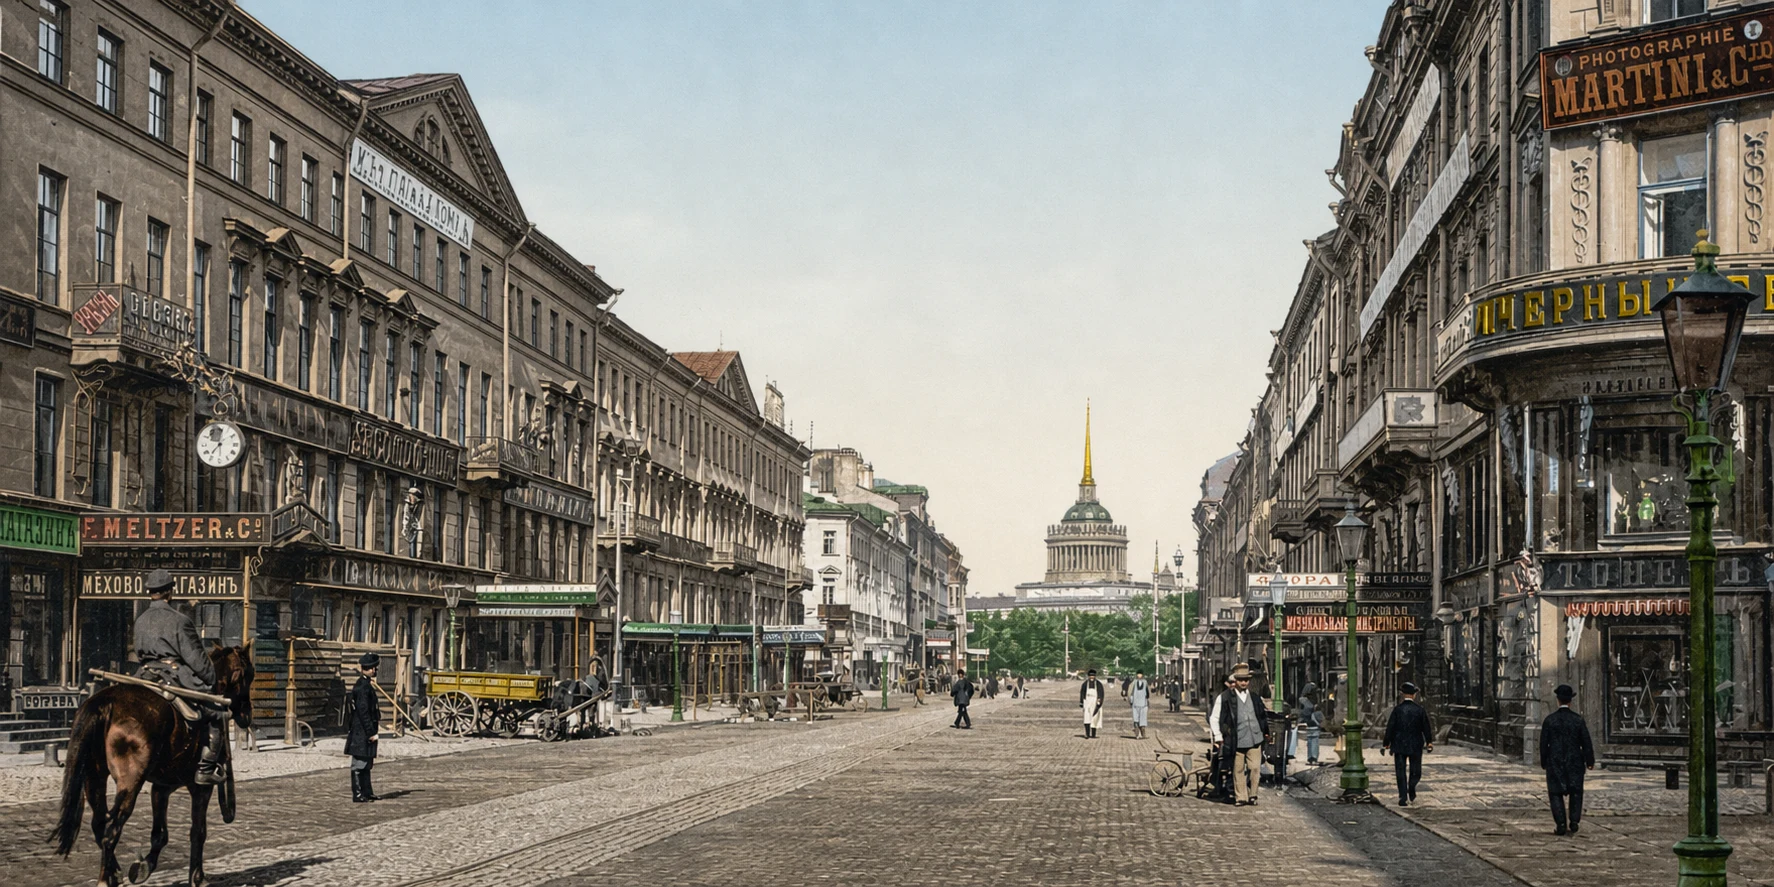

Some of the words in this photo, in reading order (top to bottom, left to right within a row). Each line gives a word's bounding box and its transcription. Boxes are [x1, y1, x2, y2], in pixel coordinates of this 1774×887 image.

[1579, 27, 1735, 70] PHOTOGRAPHIE
[1551, 53, 1708, 118] MARTINI
[103, 517, 222, 539] MELTZER
[82, 575, 149, 594] МЕХОВО
[172, 575, 238, 594] АГАЗИНЪ
